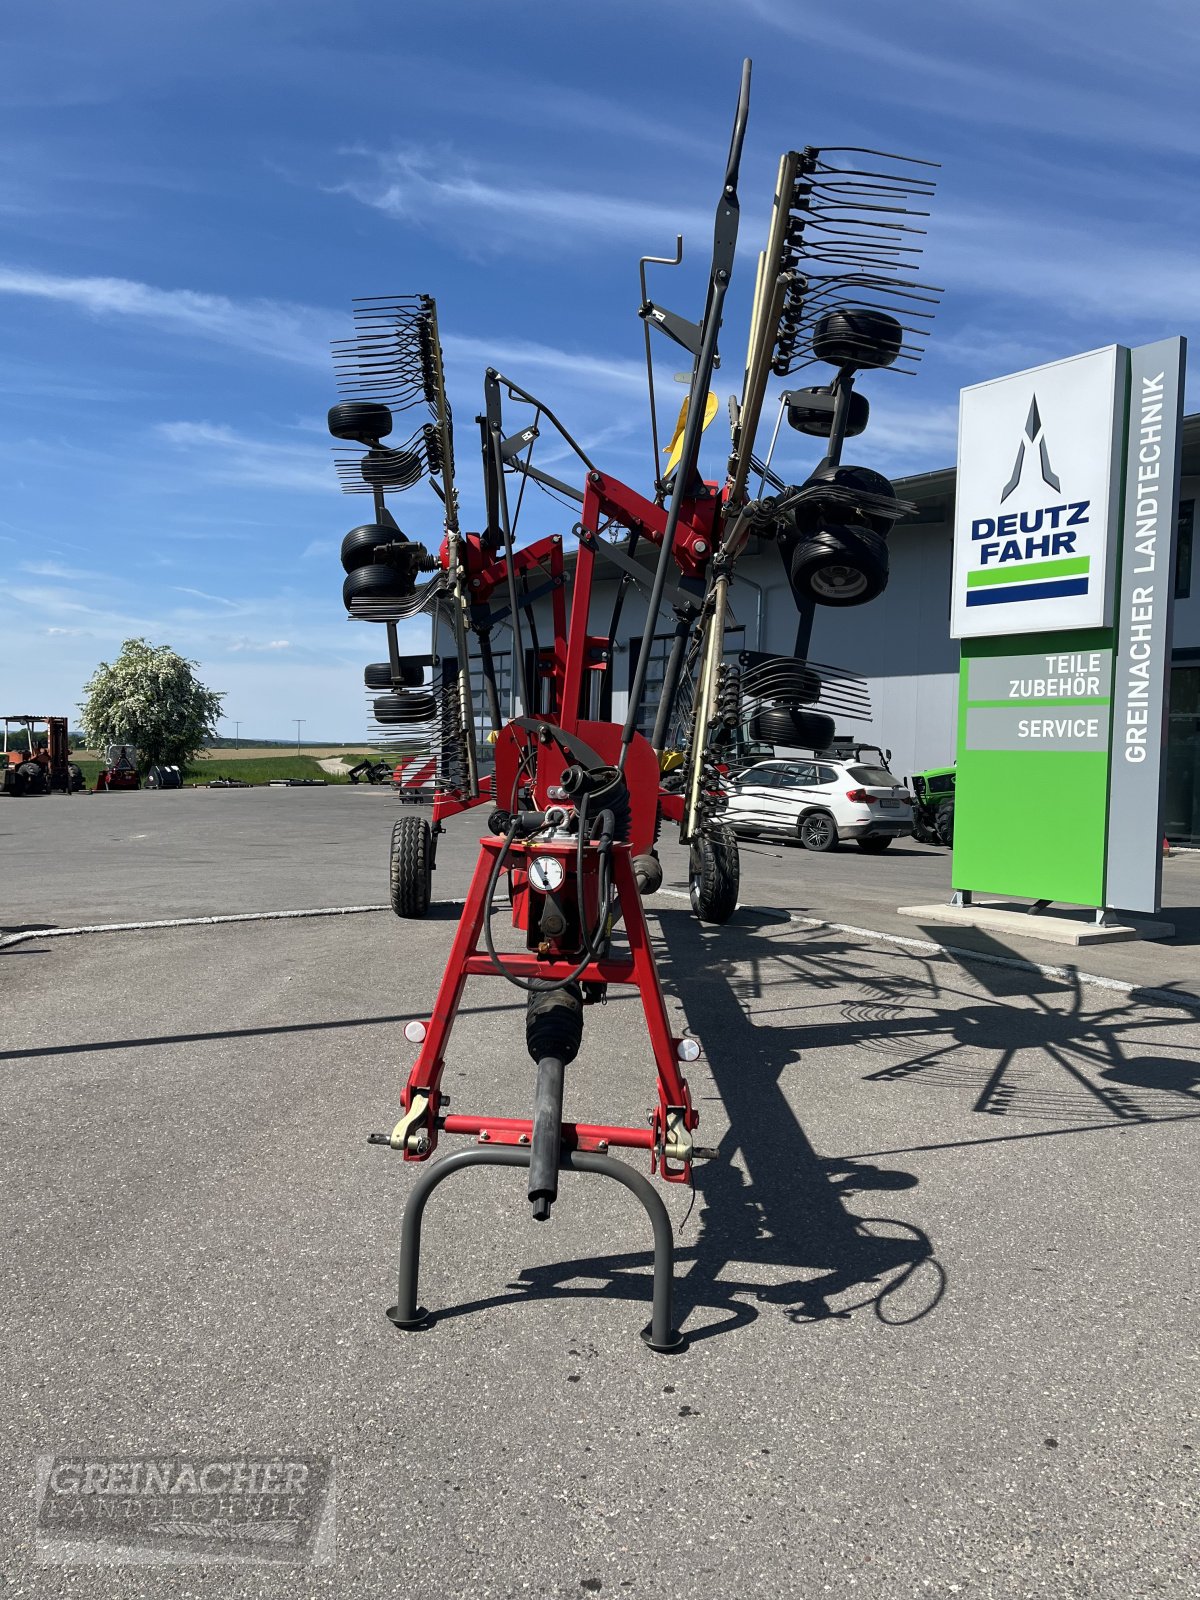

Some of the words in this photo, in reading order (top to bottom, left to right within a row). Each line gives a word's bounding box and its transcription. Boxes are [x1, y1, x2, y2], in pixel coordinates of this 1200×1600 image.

[1133, 371, 1165, 573] LANDTECHNIK
[971, 500, 1090, 541] DEUTZ
[980, 531, 1077, 565] FAHR
[1045, 653, 1101, 674] TEILE
[1125, 585, 1154, 763] GREINACHER
[1008, 672, 1100, 698] ZUBEHÖR
[1017, 719, 1098, 738] SERVICE
